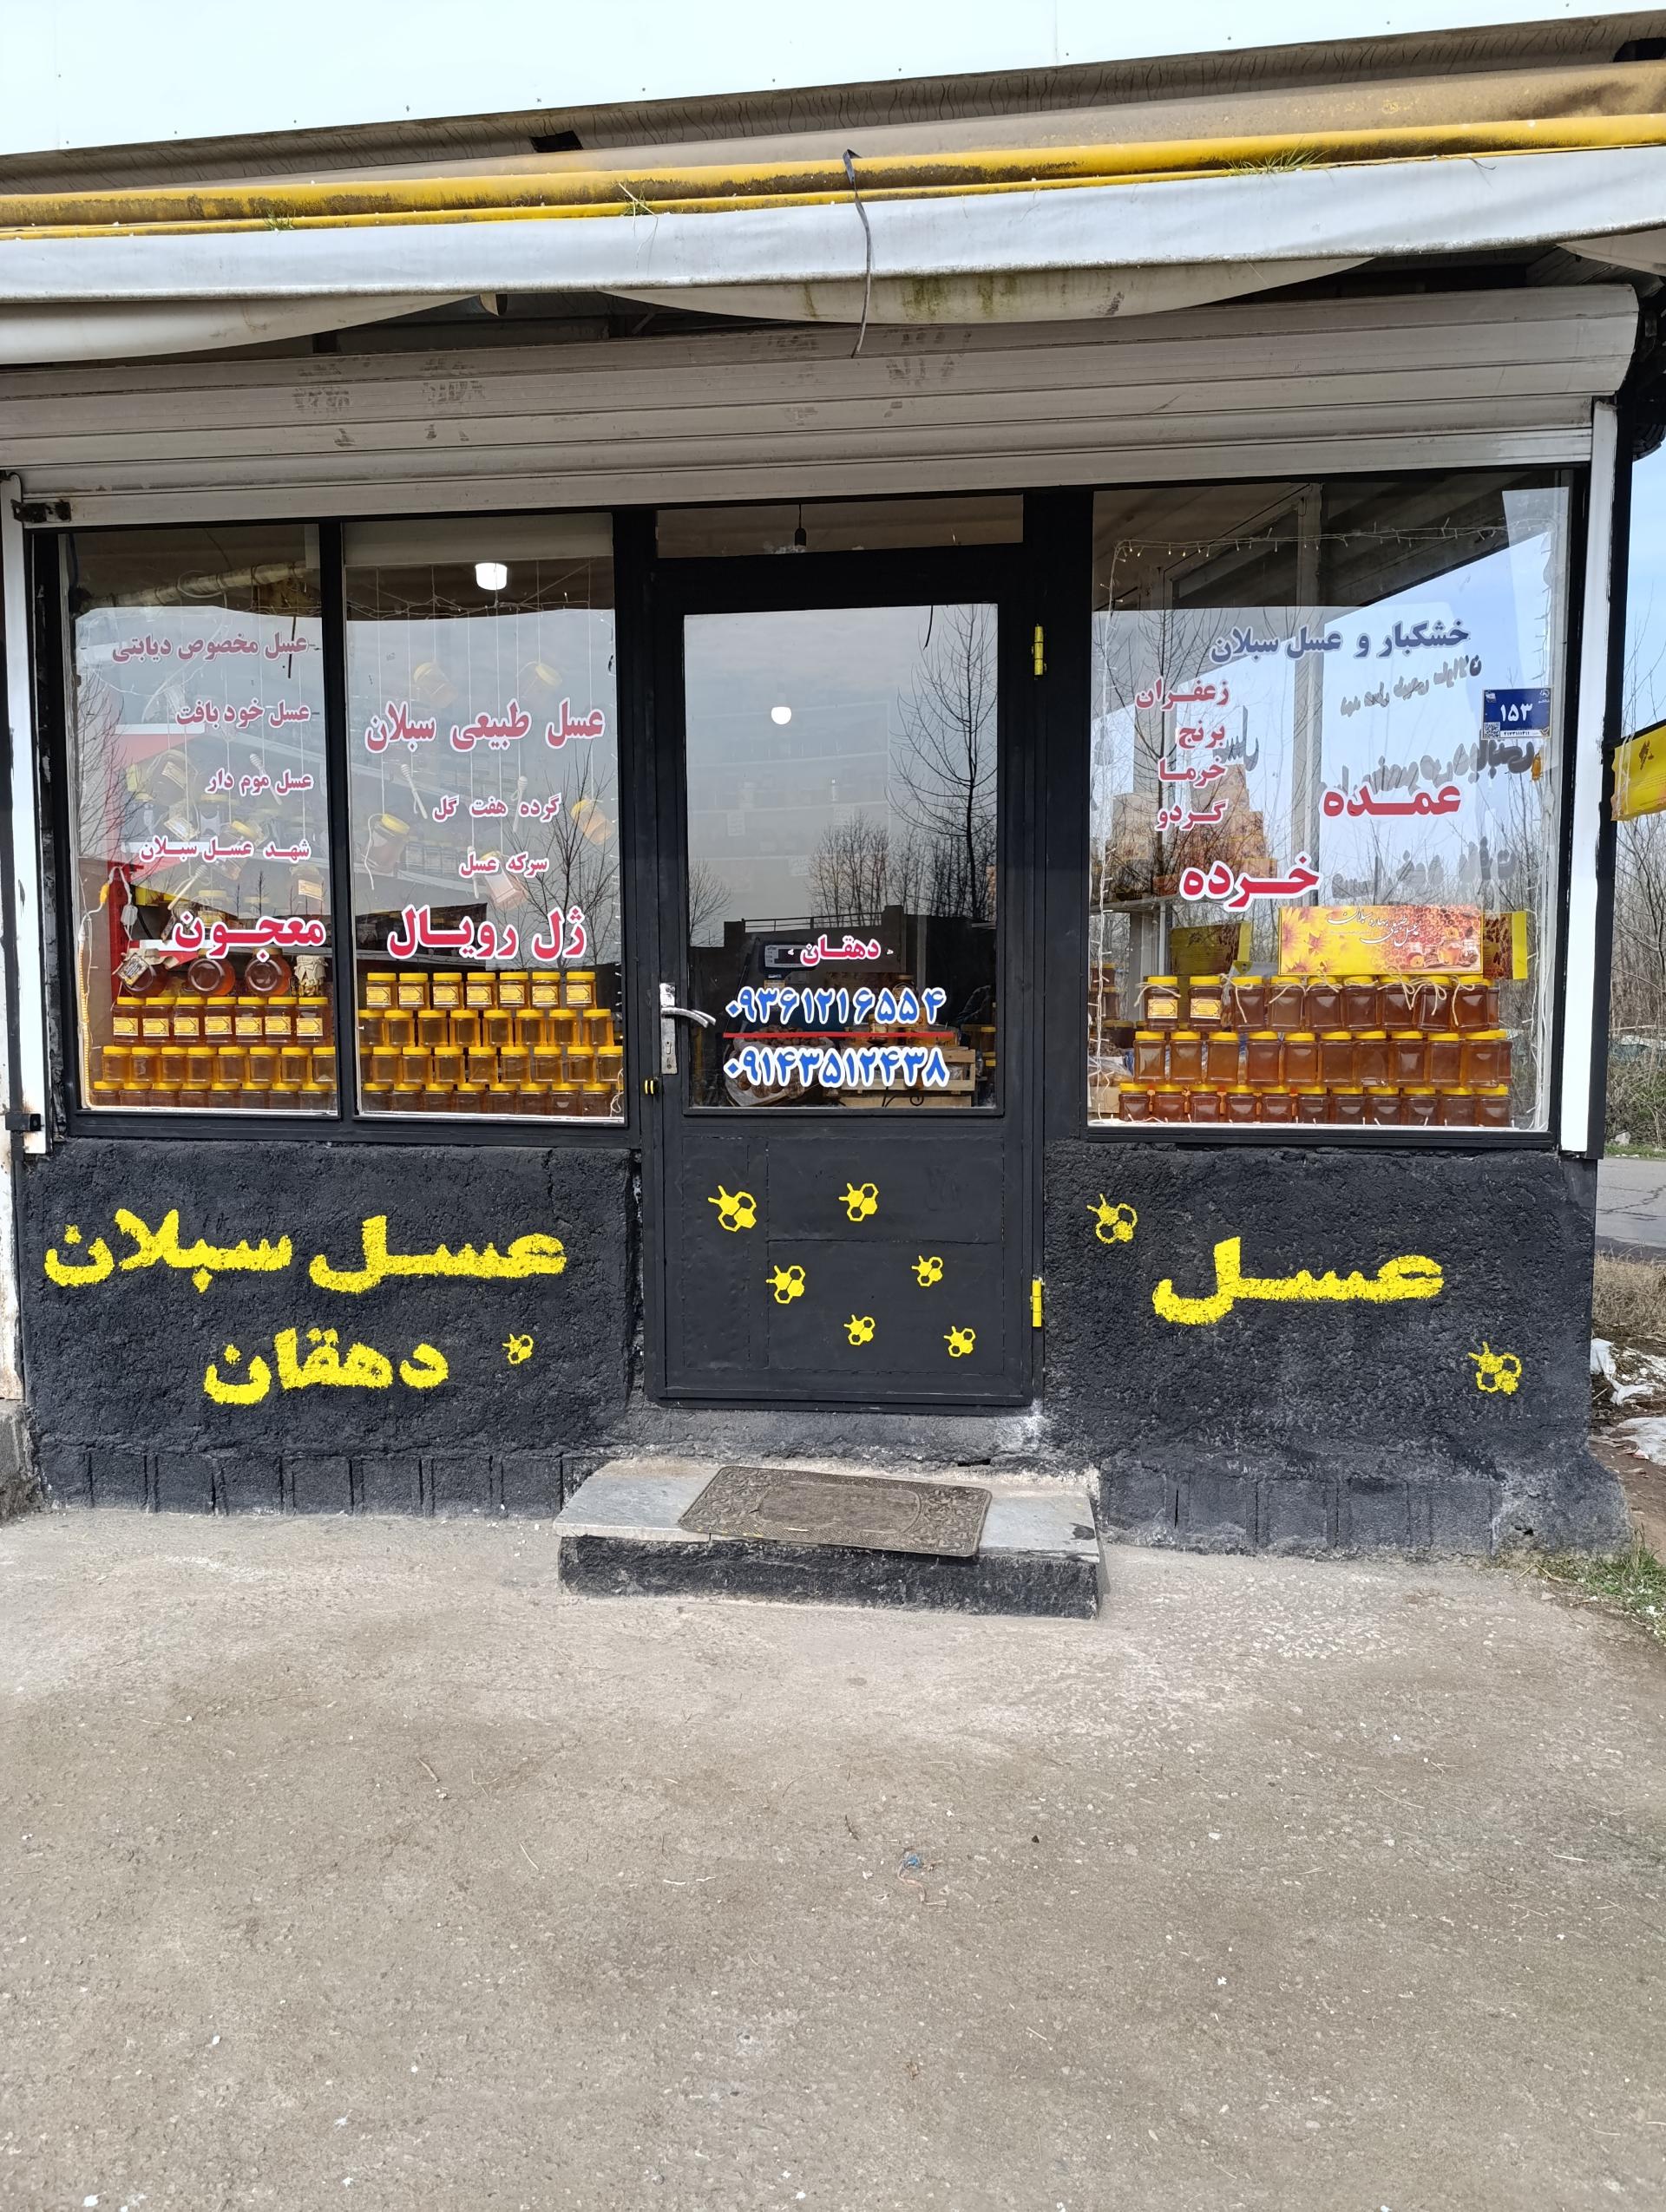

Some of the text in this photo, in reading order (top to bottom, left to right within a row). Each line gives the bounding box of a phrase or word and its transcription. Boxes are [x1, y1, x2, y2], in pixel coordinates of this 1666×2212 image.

[113, 632, 309, 663] عسل مخصوص دیابتی
[1209, 618, 1472, 663] خشکبار و عسل سبلان
[1135, 676, 1230, 710] زعفران
[176, 698, 311, 729] عسل خود بافت
[365, 697, 606, 753] عسل طبیعی سبلان
[1500, 704, 1533, 722] ۱۵۳
[1177, 719, 1226, 749] برنج
[206, 769, 314, 796] عسل موم دار
[1158, 756, 1227, 788] خرما
[433, 793, 561, 822] گرده هفت گل
[1155, 799, 1230, 831] گردو
[1320, 784, 1462, 817] عمده
[140, 835, 311, 862] شهد عسل سبلان
[459, 851, 549, 878] سرکه عسل
[1179, 852, 1322, 912] خرده
[174, 912, 325, 962] معجون
[387, 904, 587, 959] ژل رویال
[800, 934, 881, 967] دهقان
[725, 986, 947, 1024] ۰۹۳۶۱۲۱۶۵۵۴
[724, 1045, 950, 1088] ۰۹۱۴۳۵۱۲۴۳۸
[44, 1208, 567, 1294] عسل سبلان
[1152, 1236, 1445, 1325] عسل
[203, 1326, 448, 1406] دهقان
